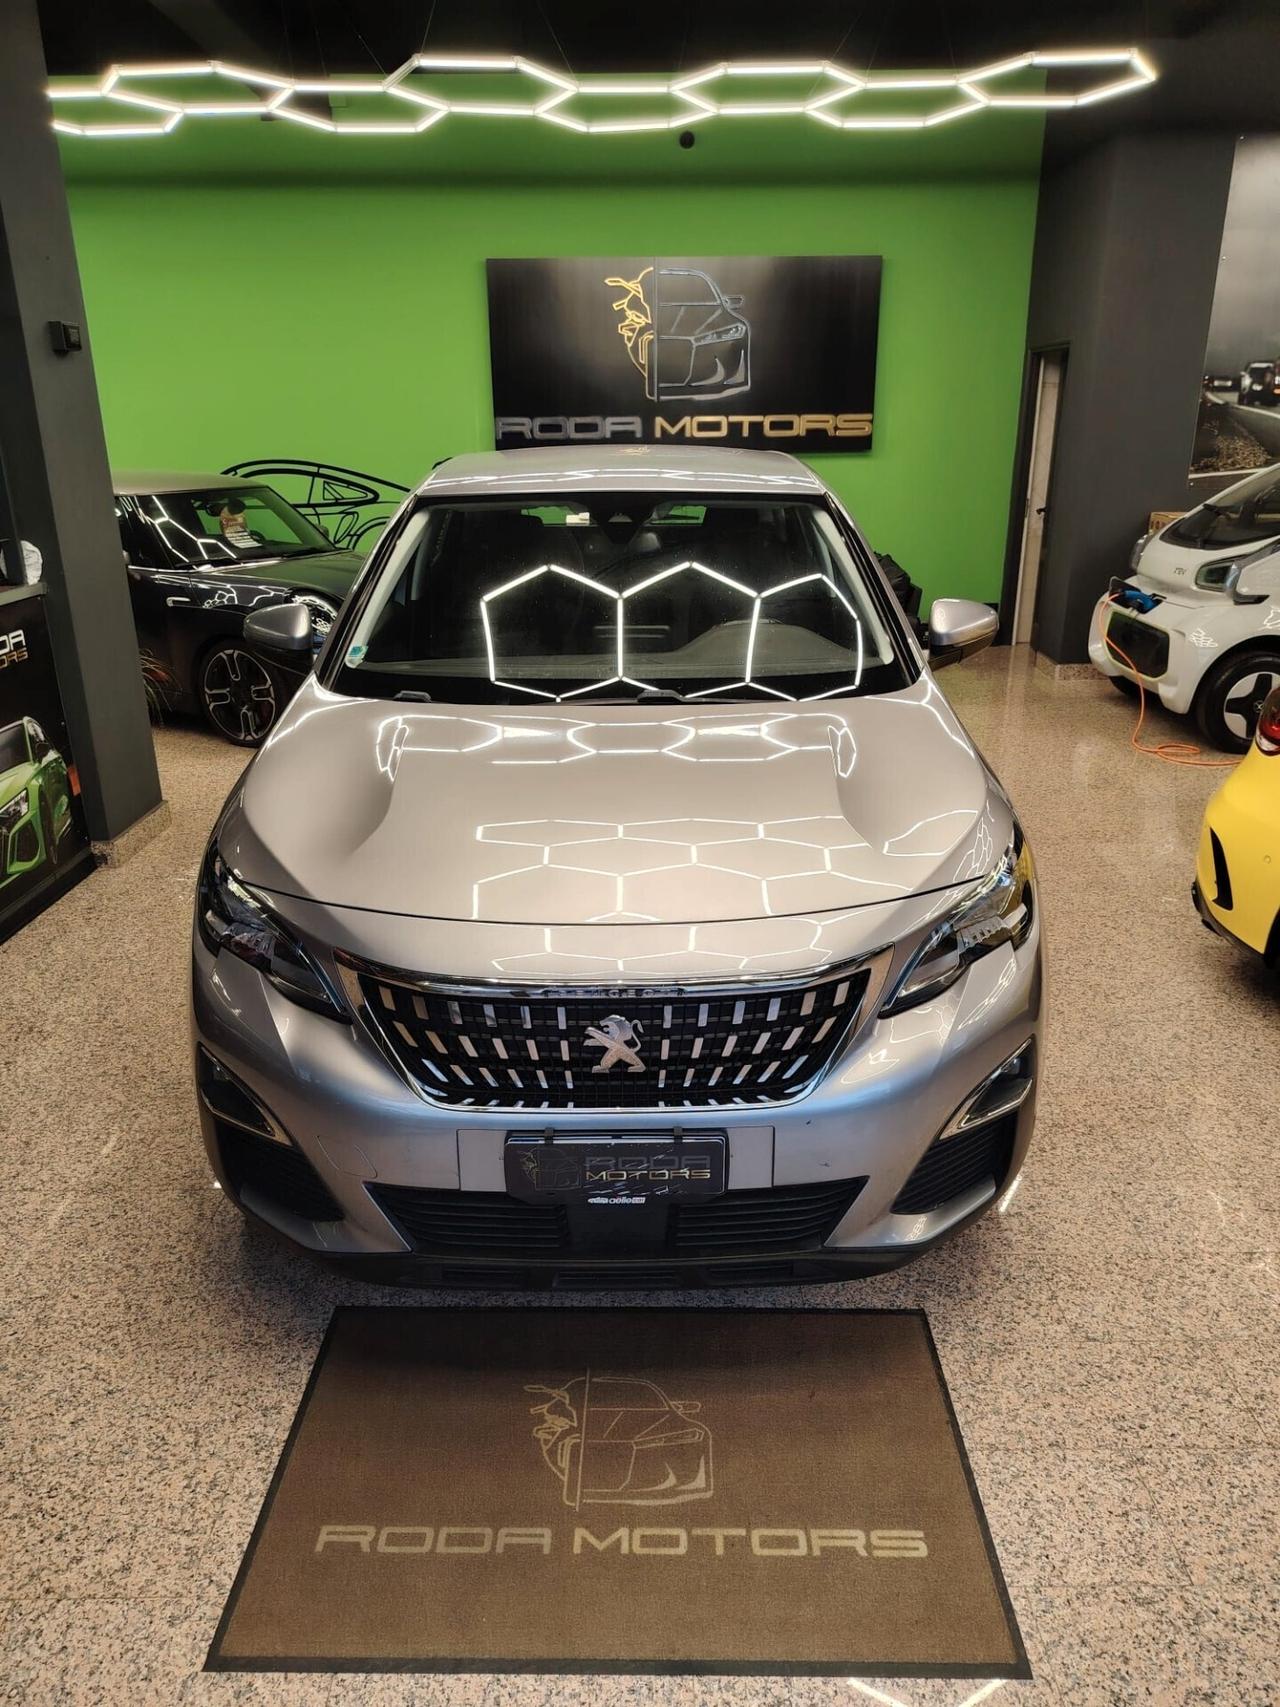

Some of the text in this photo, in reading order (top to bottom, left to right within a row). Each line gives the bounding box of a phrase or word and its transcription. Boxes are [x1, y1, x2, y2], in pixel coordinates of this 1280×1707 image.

[496, 414, 873, 440] RODA MOTORS
[585, 1169, 711, 1181] MOTORS
[314, 1525, 929, 1558] RODA MOTORS
